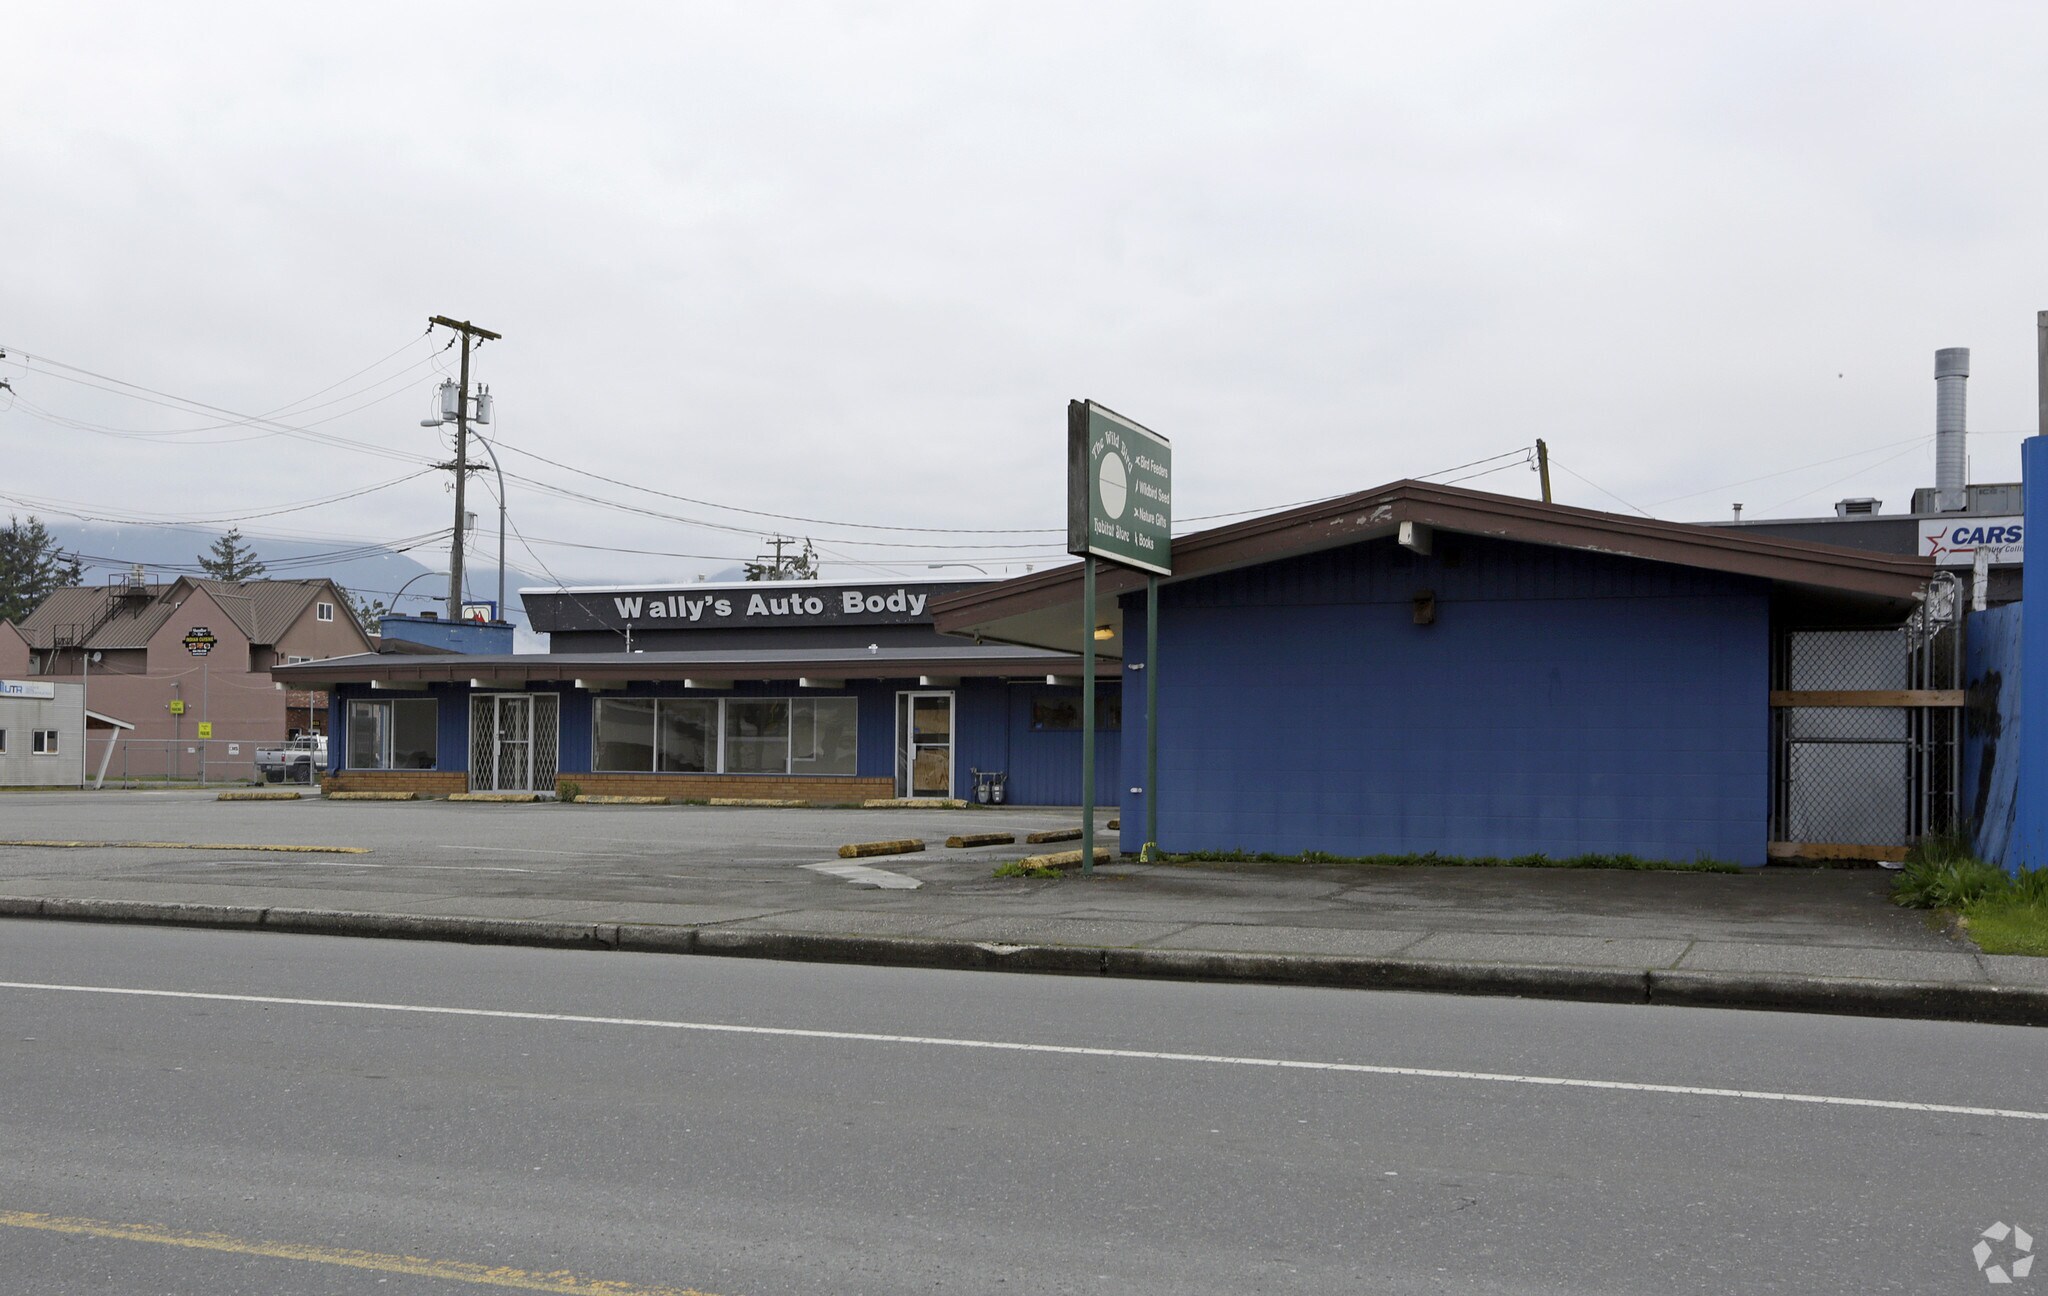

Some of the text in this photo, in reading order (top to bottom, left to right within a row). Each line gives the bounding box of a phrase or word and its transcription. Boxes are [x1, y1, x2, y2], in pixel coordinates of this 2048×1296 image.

[1091, 431, 1133, 474] The Wild Bird
[1140, 455, 1168, 478] Bird Feeders
[1139, 480, 1170, 505] Wildbird Seed
[1139, 507, 1167, 528] Nature Gifts
[1139, 532, 1154, 550] Books
[1952, 525, 2023, 545] CARS
[613, 588, 928, 622] Wally's Auto Body
